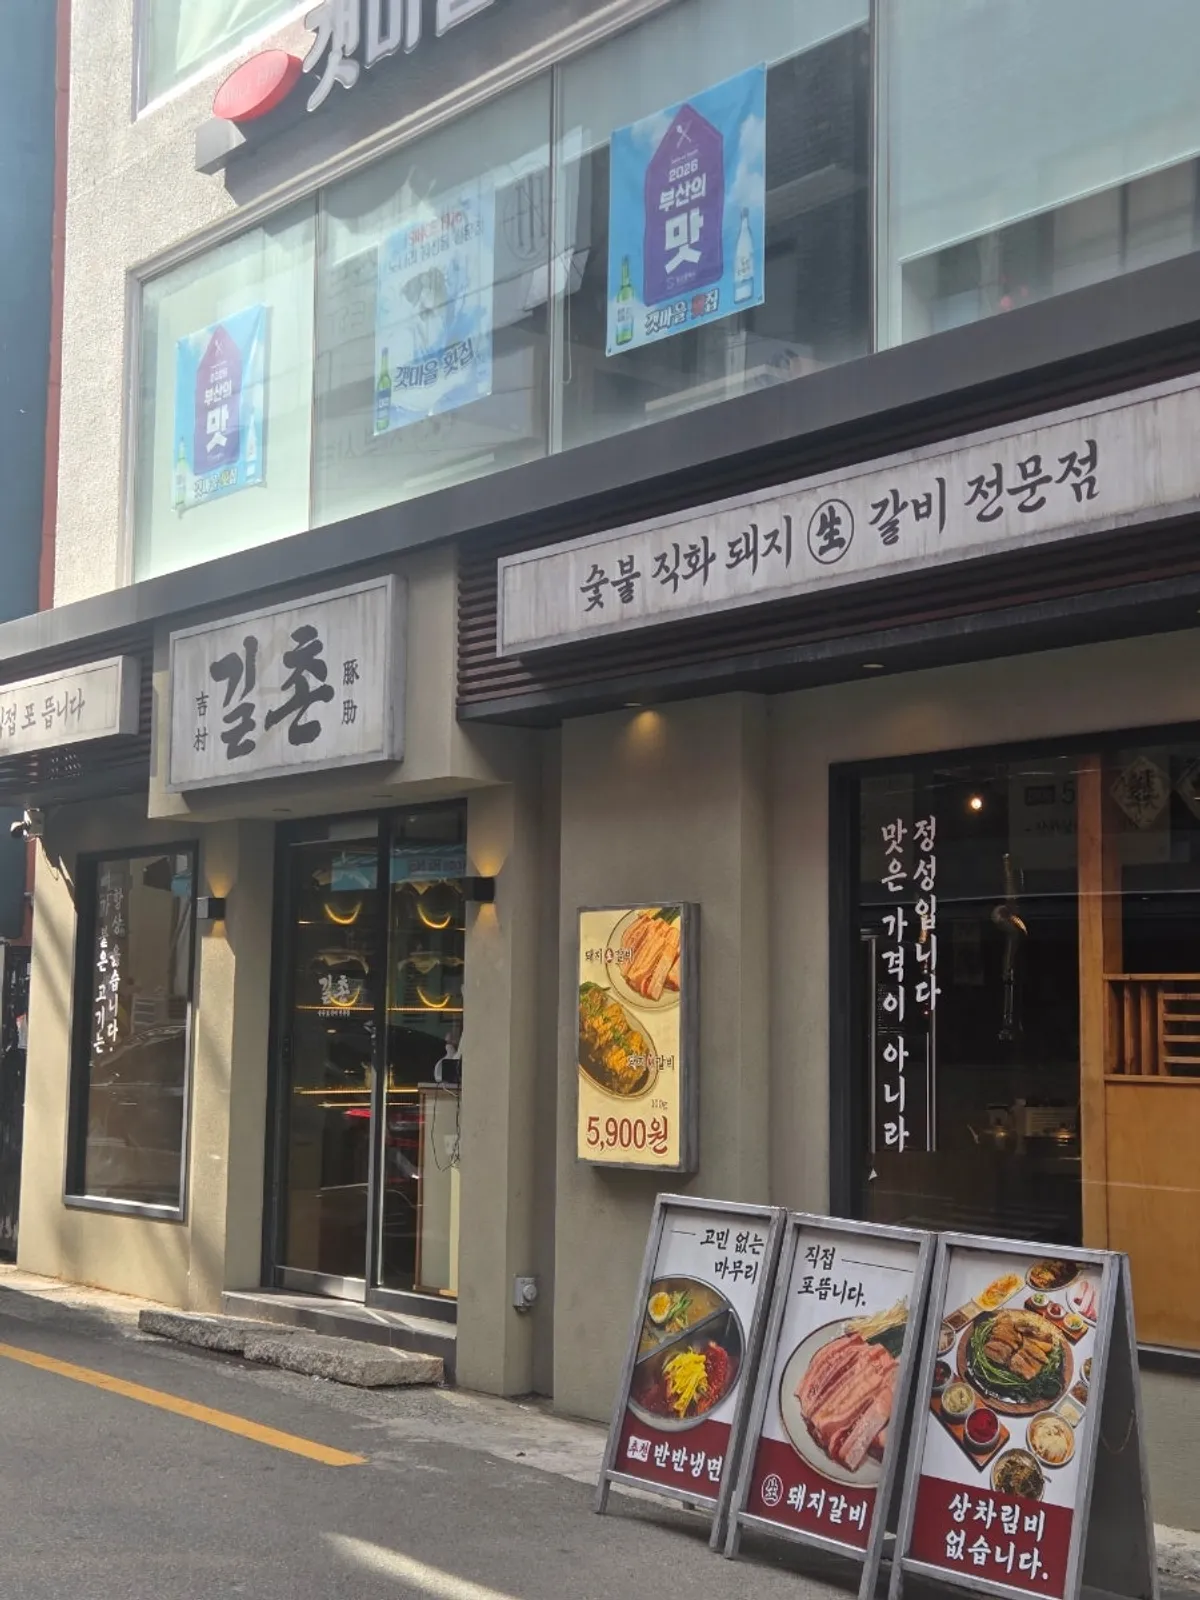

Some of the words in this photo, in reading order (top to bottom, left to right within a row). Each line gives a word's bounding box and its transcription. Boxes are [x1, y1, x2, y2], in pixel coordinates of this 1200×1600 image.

[659, 173, 706, 211] 부산의
[668, 158, 698, 182] 2026
[664, 207, 704, 274] 맛
[645, 300, 687, 335] 갯마을
[395, 359, 439, 389] 갯마을
[443, 338, 475, 377] 횟집
[204, 379, 232, 405] 부산의
[206, 404, 229, 453] 맛
[580, 555, 640, 612] 숯불
[652, 536, 716, 593] 직화
[726, 515, 792, 577] 돼지
[868, 477, 946, 545] 갈비
[964, 439, 1100, 522] 전문점
[21, 703, 36, 730] 포
[41, 688, 86, 730] 뜹니다
[210, 625, 335, 760] 길촌
[881, 818, 907, 891] 맛은
[913, 815, 941, 1010] 정성입니다
[882, 907, 908, 1022] 가격이
[93, 984, 107, 1054] 고기는
[883, 1035, 909, 1152] 아니라
[586, 1115, 668, 1154] 5,900원
[700, 1228, 730, 1250] 고민
[735, 1231, 764, 1255] 없는
[805, 1244, 836, 1270] 직접
[715, 1256, 759, 1285] 마무리
[797, 1275, 867, 1308] 포뜹니다.
[654, 1441, 723, 1482] 반반냉면
[787, 1483, 867, 1531] 돼지갈비
[948, 1492, 1046, 1542] 상차림비
[945, 1529, 1049, 1580] 없습니다.
